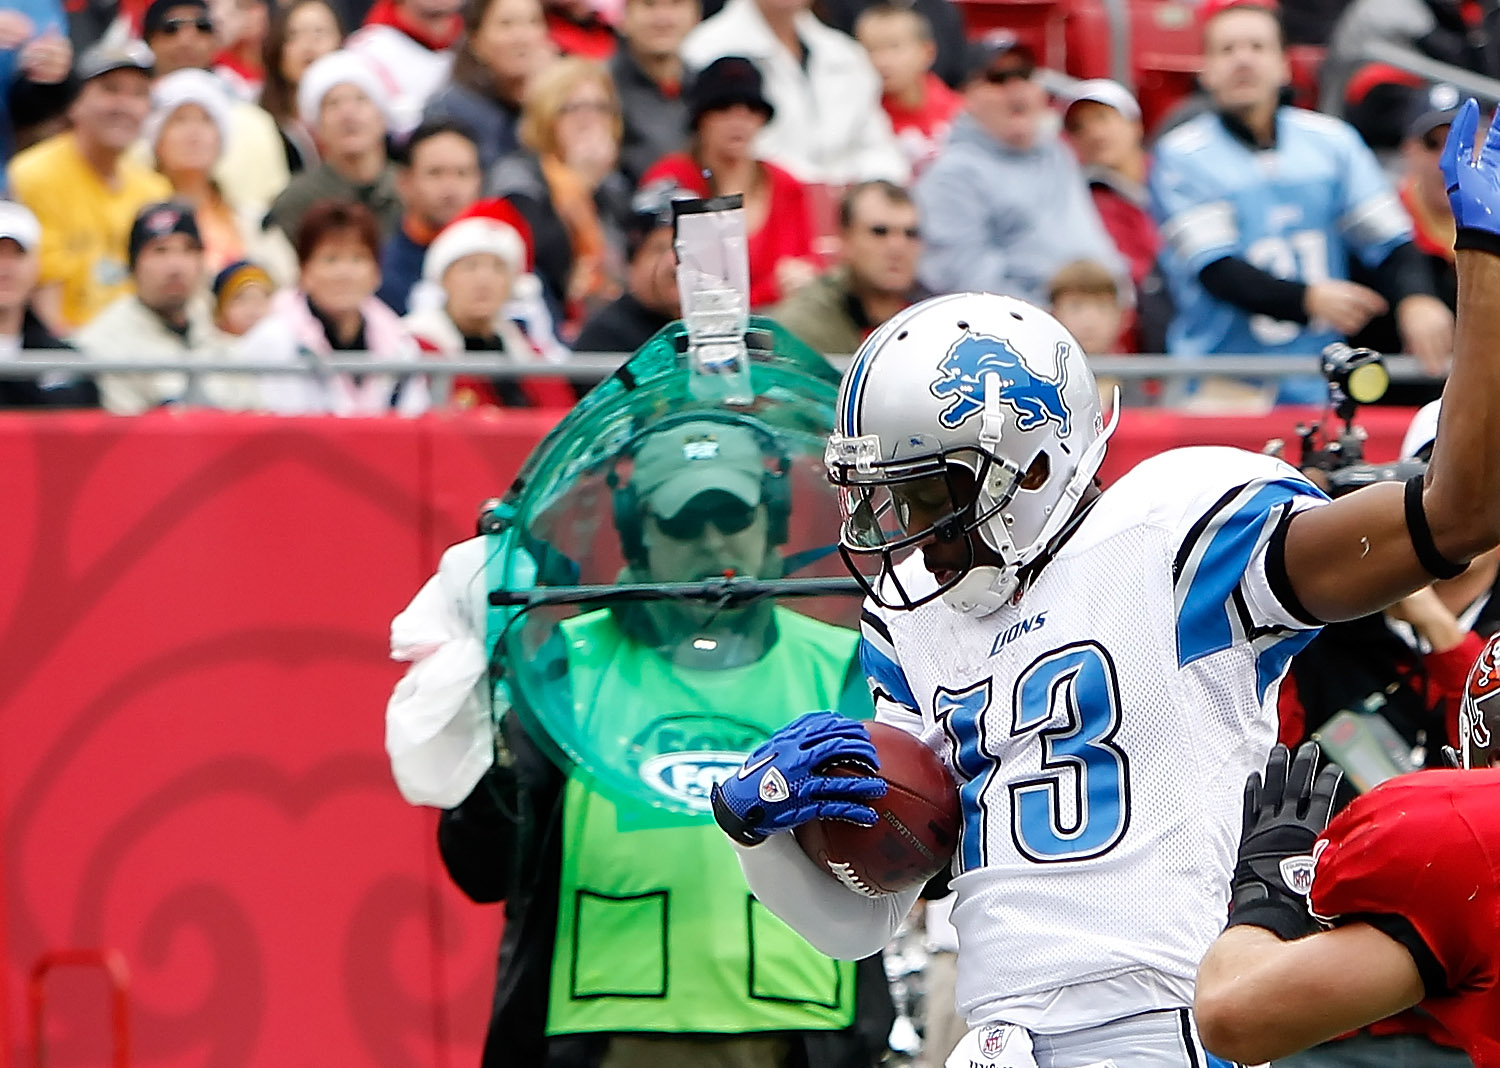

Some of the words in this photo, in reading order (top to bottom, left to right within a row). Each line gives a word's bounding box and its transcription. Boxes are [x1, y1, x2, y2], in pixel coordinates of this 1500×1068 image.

[987, 610, 1049, 659] LIONS
[933, 640, 1131, 872] 13
[883, 810, 911, 839] LEAGUE
[983, 1036, 1002, 1052] NFL
